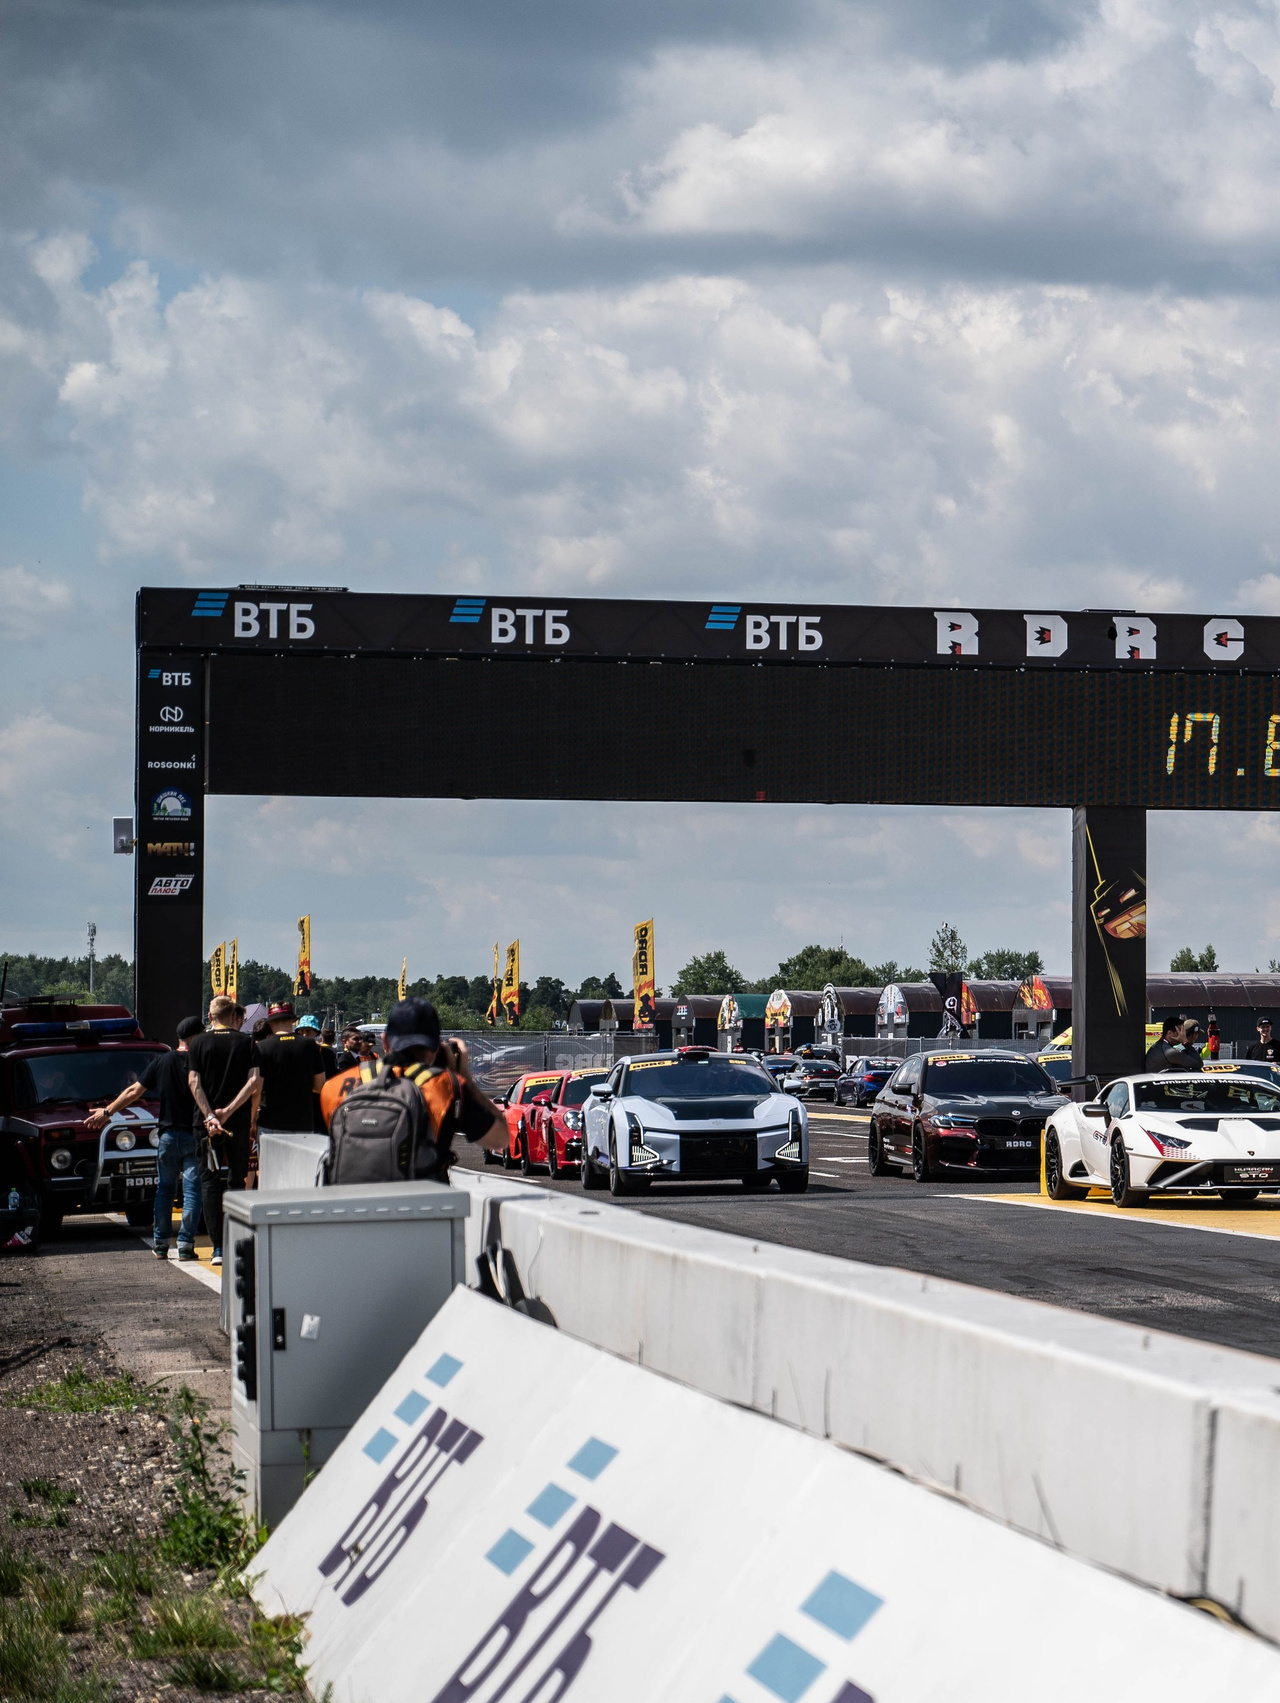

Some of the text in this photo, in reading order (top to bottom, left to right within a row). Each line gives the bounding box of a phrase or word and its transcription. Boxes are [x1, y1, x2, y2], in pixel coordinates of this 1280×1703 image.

[234, 602, 315, 639] ВТБ
[491, 608, 570, 645] ВТБ
[745, 614, 823, 651] ВТБ
[162, 672, 192, 686] ВТБ
[149, 725, 195, 733] НОРНИКЕЛЬ
[147, 842, 195, 856] МАТЧ!
